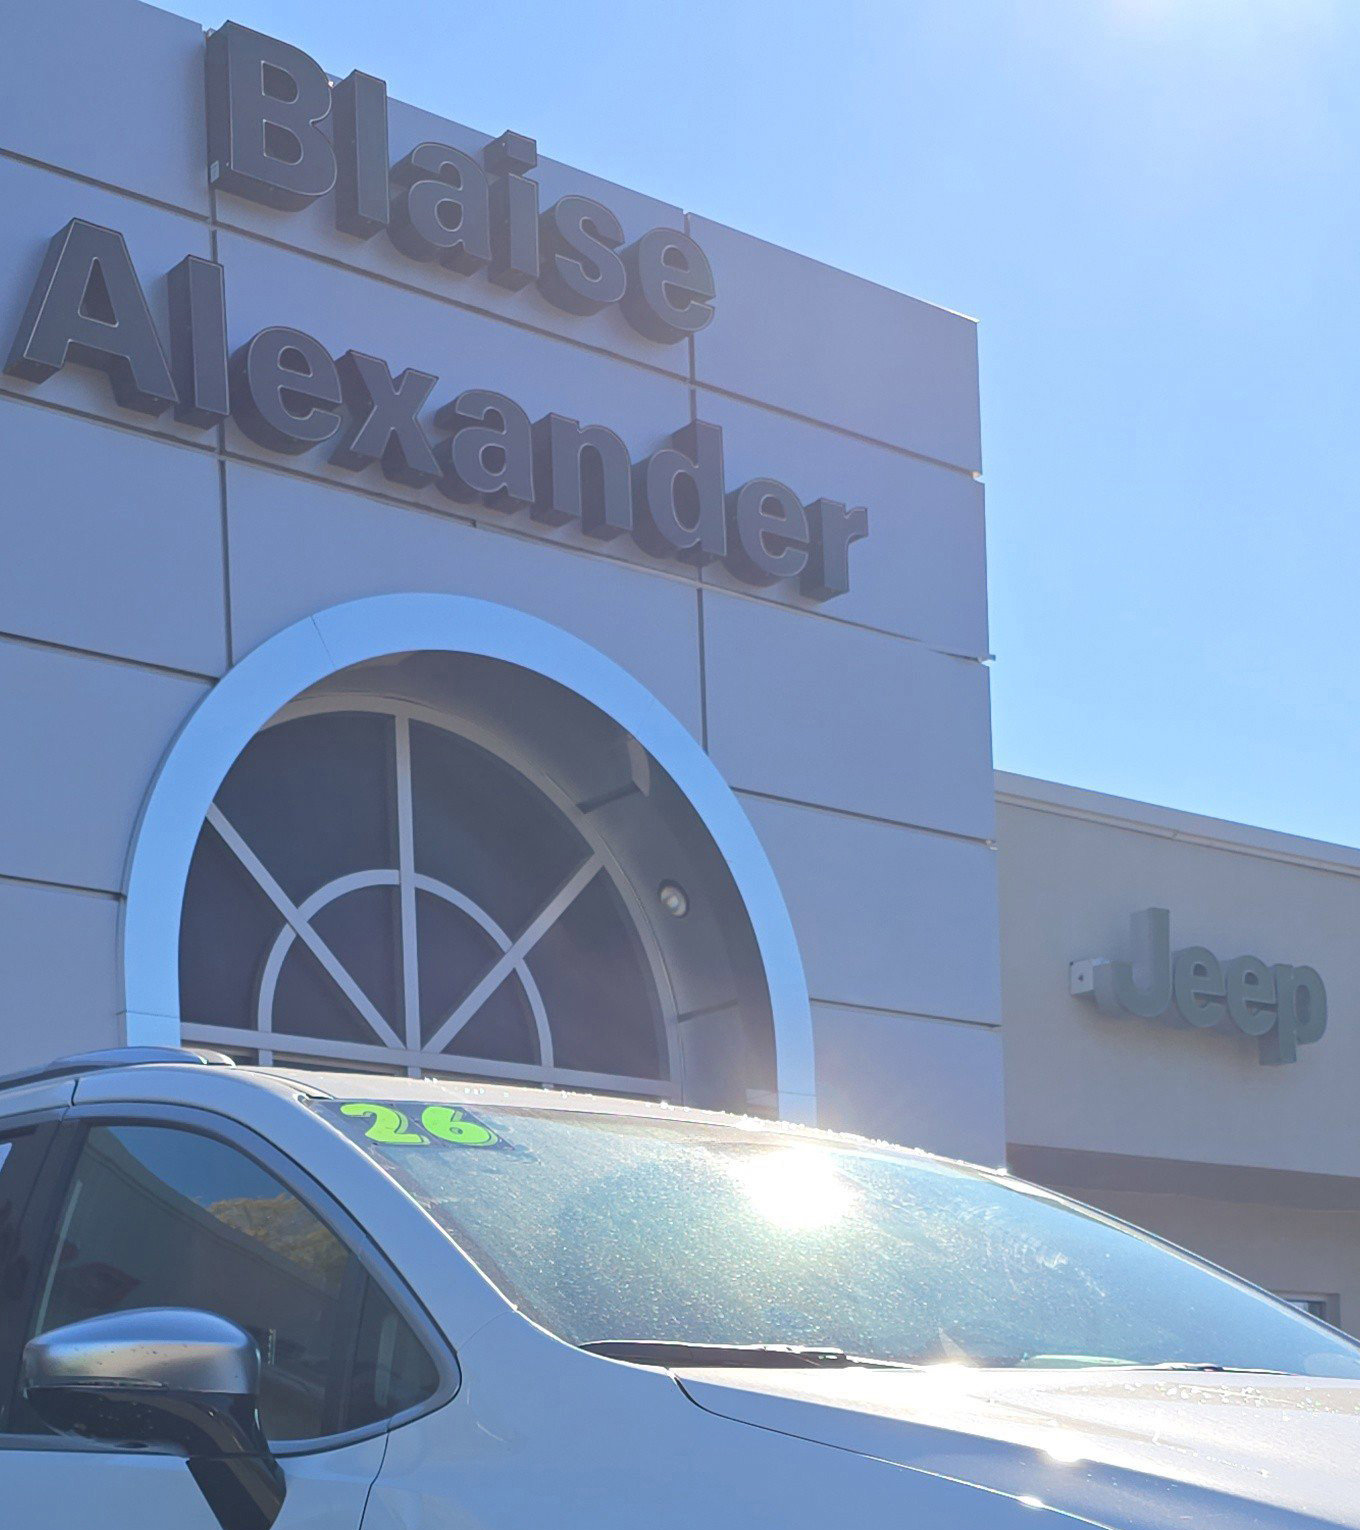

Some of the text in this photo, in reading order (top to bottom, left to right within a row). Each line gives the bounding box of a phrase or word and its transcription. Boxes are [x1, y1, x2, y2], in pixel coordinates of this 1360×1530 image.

[205, 20, 717, 344] Blaise
[3, 217, 869, 600] Alexander
[1096, 907, 1328, 1066] Jeep
[340, 1102, 499, 1147] 26
